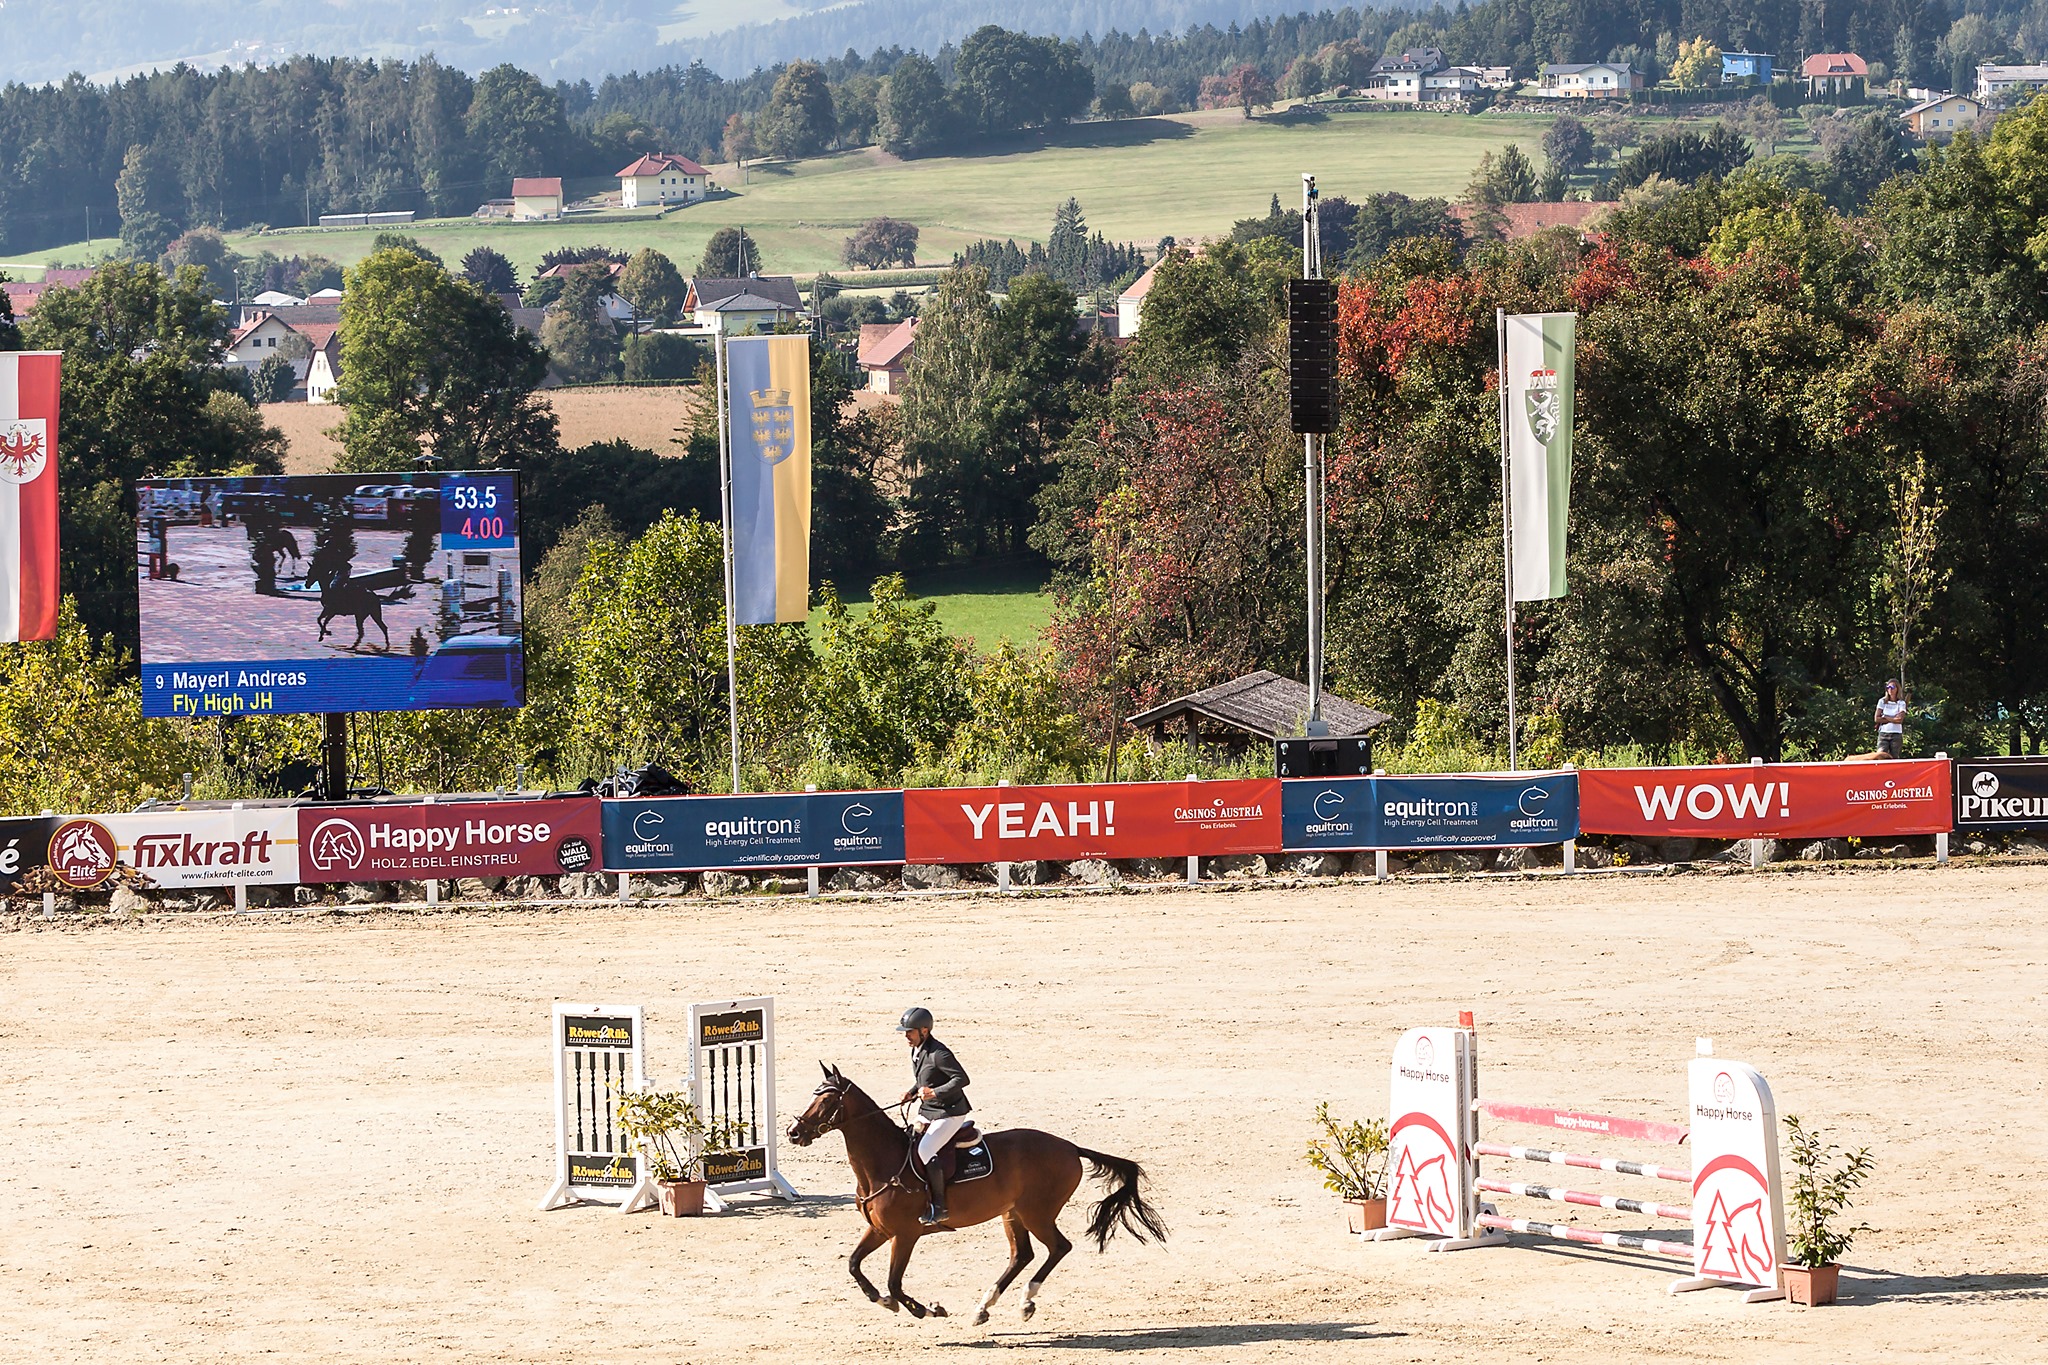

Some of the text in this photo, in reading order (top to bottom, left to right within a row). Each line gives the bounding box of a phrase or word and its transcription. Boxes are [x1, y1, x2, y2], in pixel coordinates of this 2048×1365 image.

[454, 486, 497, 509] 53.5
[461, 517, 503, 539] 4.00
[155, 670, 307, 693] 9 Mayerl Andreas
[173, 692, 273, 716] Fly High JH
[1846, 786, 1933, 801] CASINOS AUSTRIA
[1384, 798, 1469, 818] equitron
[1633, 782, 1790, 821] WOW!
[960, 801, 1115, 839] YEAH!
[1174, 805, 1263, 820] CASINOS AUSTRIA
[705, 816, 792, 838] equitron
[1306, 822, 1349, 833] equitron
[1384, 818, 1478, 828] High Energy Cell Treatment
[1510, 817, 1554, 829] equitron
[370, 820, 551, 853] Happy Horse
[705, 836, 801, 848] High Energy Cell Treatment
[834, 836, 878, 847] equitron
[1460, 834, 1496, 842] approved
[133, 831, 272, 867] fixkraft
[625, 843, 669, 854] equitron
[371, 854, 521, 869] HOLZ.EDEL.EINSTREU.
[560, 853, 590, 865] VIERTEL
[784, 853, 820, 861] approved
[182, 869, 273, 879] www.fixkraft-elite.com
[1400, 1066, 1449, 1083] Happy Horse
[1697, 1105, 1752, 1121] Happy Horse
[1554, 1113, 1609, 1131] happy-horse.at
